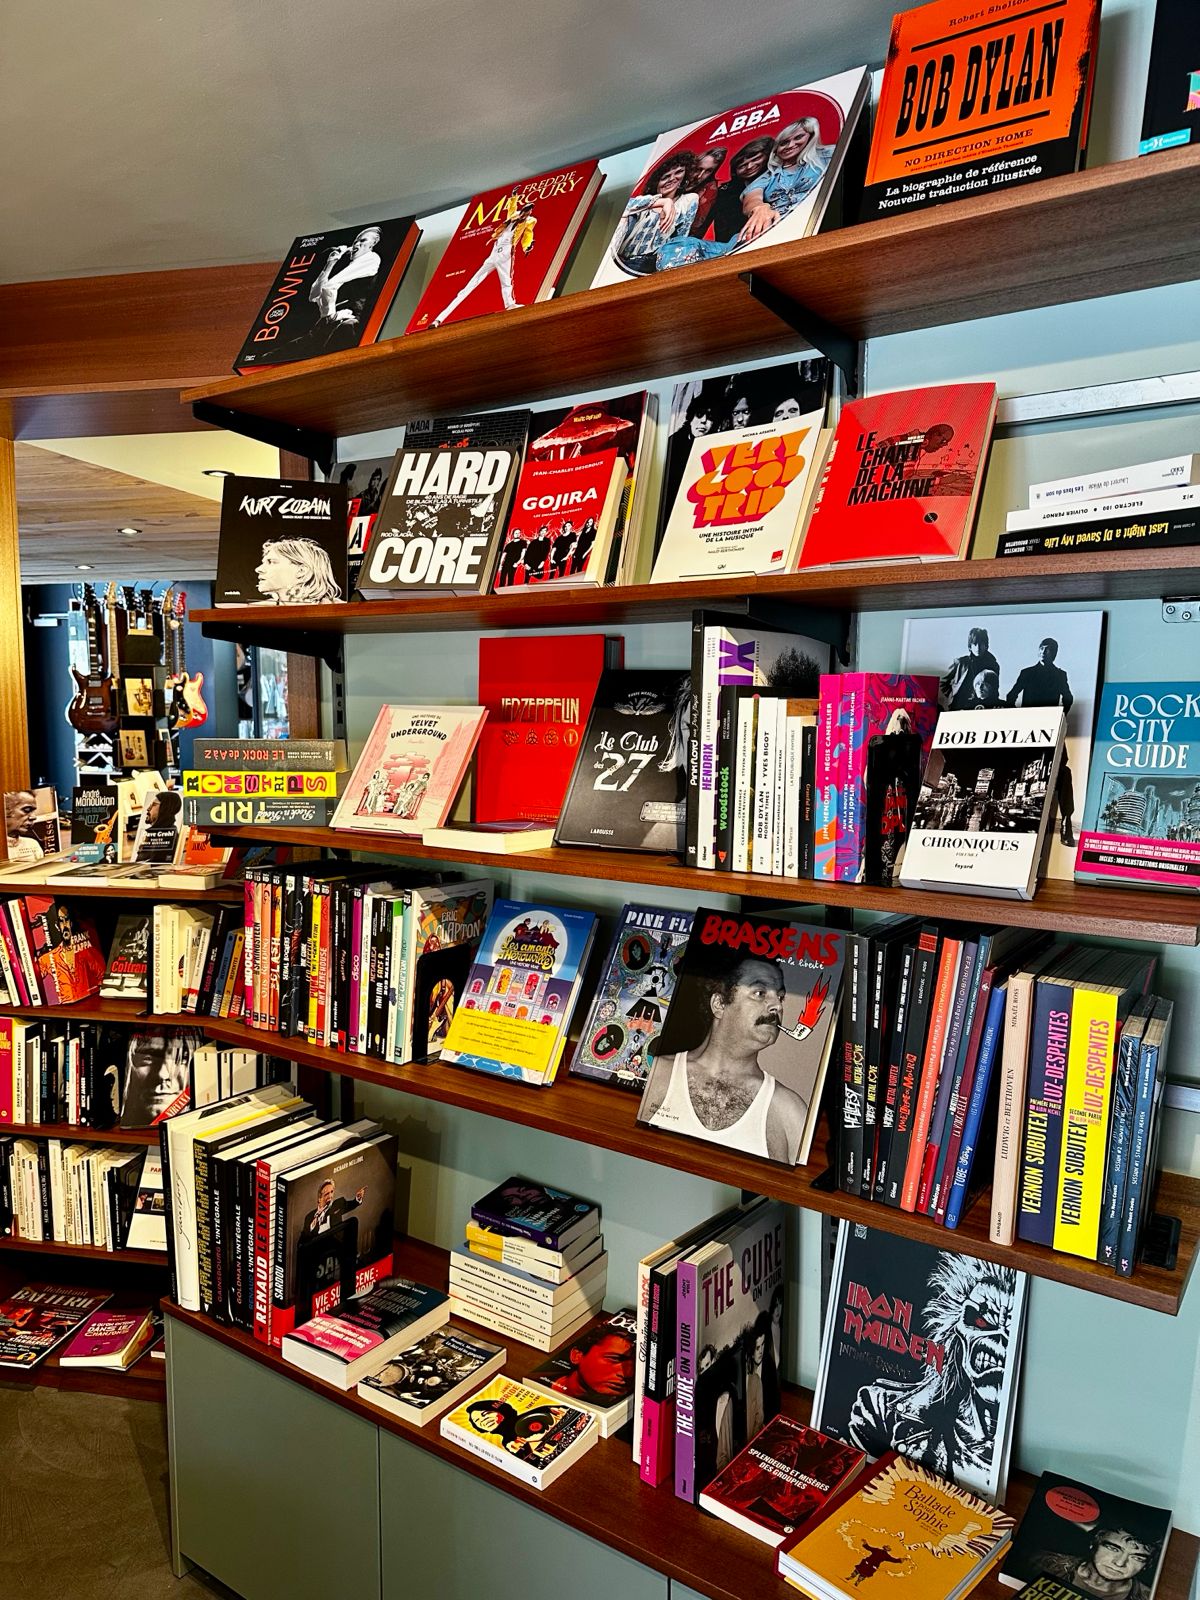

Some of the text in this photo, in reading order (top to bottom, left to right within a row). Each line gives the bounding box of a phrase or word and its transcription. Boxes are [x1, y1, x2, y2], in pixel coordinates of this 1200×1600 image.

[895, 18, 1064, 139] BOB DYLAN
[709, 104, 781, 140] ABBA
[904, 157, 921, 168] NO
[924, 140, 992, 163] DIRECTION
[996, 128, 1033, 145] HOME
[522, 171, 577, 194] FREDDIE
[878, 165, 1042, 210] Nouvelle traduction illustrée
[254, 253, 316, 342] BOWIE
[409, 420, 430, 433] NADA
[856, 431, 878, 451] LE
[701, 426, 812, 475] VERY
[860, 443, 920, 469] CHANT
[392, 451, 511, 496] HARD
[687, 455, 806, 504] GOOD
[239, 495, 331, 518] KURT COBAIN
[522, 486, 598, 512] GOJIRA
[692, 485, 785, 529] TRIP
[847, 475, 936, 507] MACHINE
[1043, 508, 1089, 519] OLIVIER PERNOT
[713, 530, 742, 538] HISTOIRE
[742, 526, 764, 534] INTIME
[725, 533, 754, 542] MUSIQUE
[1044, 522, 1169, 548] Last Night a DJ Saved My Life
[369, 536, 488, 584] CORE
[1113, 693, 1200, 718] ROCK
[390, 727, 448, 741] UNDERGROUND
[410, 718, 439, 729] VELVET
[938, 729, 1055, 745] BOB DYLAN
[1110, 719, 1176, 743] CITY
[228, 750, 240, 761] de
[243, 749, 270, 761] ROCK
[272, 750, 285, 761] LE
[594, 731, 659, 753] Le Club
[847, 716, 855, 771] JEANNE-MARTINE
[1106, 744, 1190, 769] GUIDE
[593, 761, 605, 769] des
[593, 753, 656, 792] 27
[702, 744, 714, 791] HENDRIX
[824, 749, 832, 772] RÉGIS
[75, 796, 115, 807] Manoukian
[82, 790, 100, 799] André
[718, 766, 729, 830] woodstock
[847, 784, 856, 832] JANIS JOPLIN
[157, 830, 175, 838] Grohl
[590, 828, 614, 836] LAROUSSE
[822, 824, 830, 841] JIMI
[921, 836, 1019, 853] CHRONIQUES
[441, 911, 458, 922] ERIC
[245, 927, 253, 986] INDOCHINE
[253, 922, 261, 970] SPRINGSTEEN
[502, 935, 555, 955] Les amants
[701, 915, 841, 967] BRASSENS
[271, 937, 280, 985] CLASH
[319, 947, 327, 990] WINEHOUSE
[959, 955, 972, 996] EFA/RUBIO
[952, 998, 964, 1020] Django
[1010, 1005, 1019, 1028] MIKAËL
[951, 1022, 960, 1038] Main
[844, 1042, 852, 1082] METAL VORTEX
[1043, 1010, 1070, 1103] LUZ-DESPENTES
[1083, 1019, 1109, 1114] LUZ-DESPENTES
[854, 1067, 863, 1084] METAL
[887, 1064, 898, 1087] VORTEX
[165, 1094, 191, 1117] NIRVANA
[886, 1088, 896, 1105] METAL
[1004, 1068, 1014, 1117] BEETHOVEN
[1001, 1126, 1010, 1160] LUDWIG
[1022, 1110, 1048, 1214] VERNON SUBUTEX
[1060, 1120, 1088, 1226] VERNON SUBUTEX
[40, 1175, 48, 1207] GAINSBOURG
[213, 1189, 221, 1244] L'INTÉGRALE
[256, 1183, 268, 1324] RENAUD LE LIVRE
[274, 1265, 284, 1300] SARDOU
[702, 1225, 783, 1327] THE CURE
[752, 1270, 783, 1302] ON TOUR
[847, 1281, 913, 1334] IRON
[843, 1308, 945, 1376] MAIDEN
[677, 1323, 693, 1437] THE CURE ON TOUR
[759, 1462, 808, 1491] DES GROUPIES
[904, 1485, 956, 1519] Ballade
[904, 1499, 949, 1532] Sophie
[917, 1503, 934, 1516] pour
